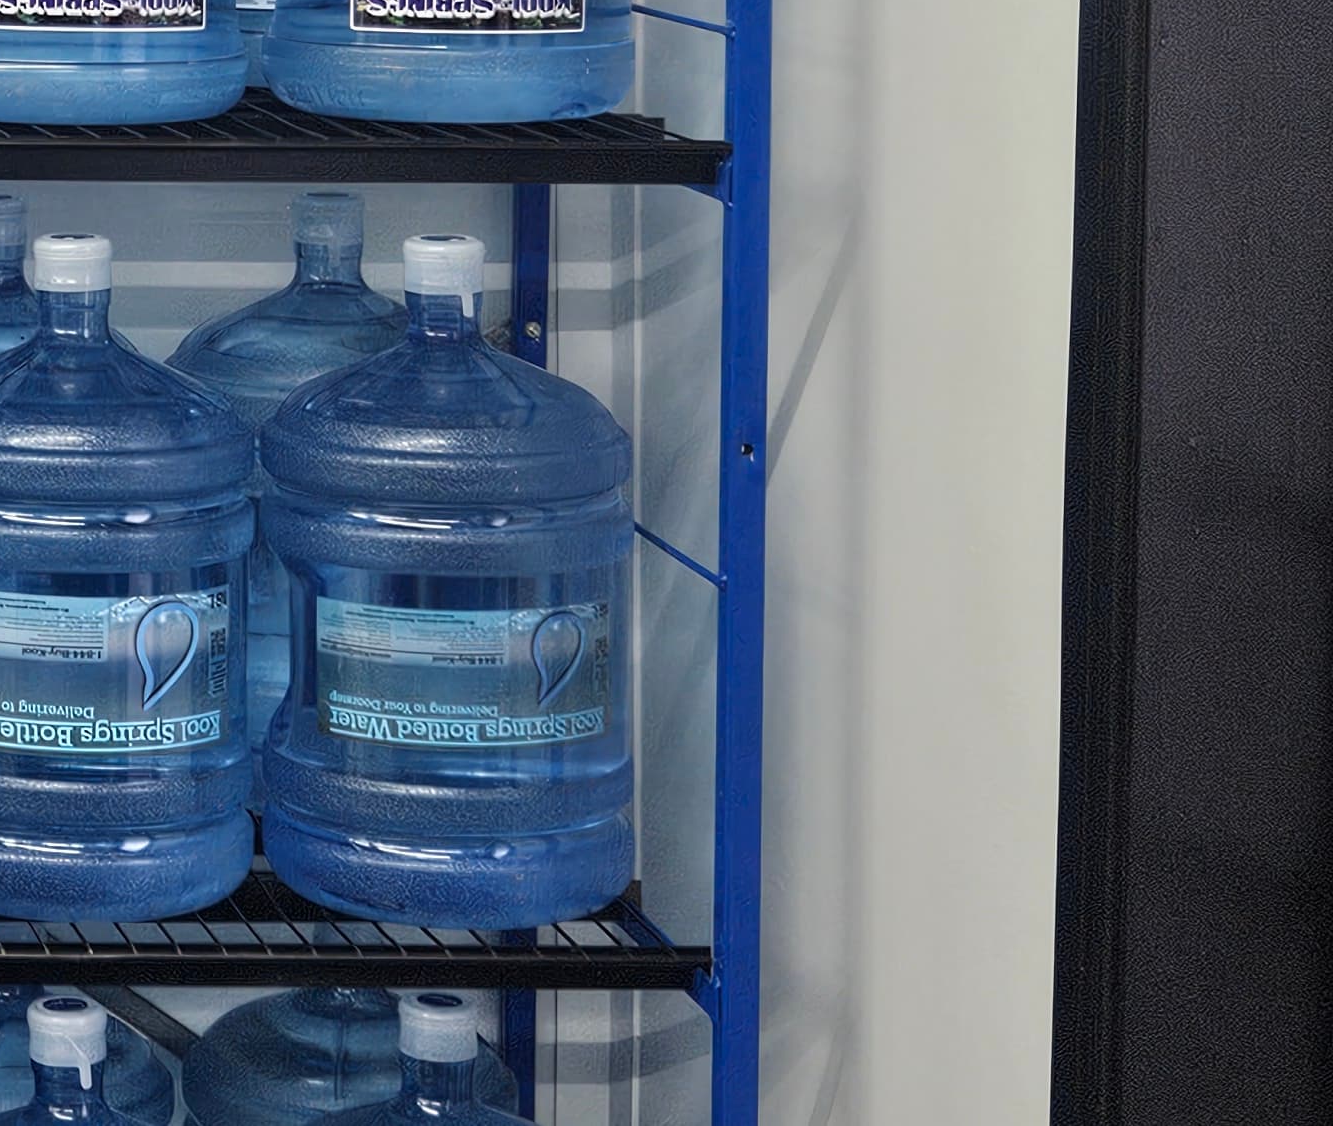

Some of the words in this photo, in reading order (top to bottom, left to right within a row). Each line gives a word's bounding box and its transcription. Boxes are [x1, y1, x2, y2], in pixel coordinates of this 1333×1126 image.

[80, 718, 175, 747] Springs
[181, 712, 222, 737] Kool
[330, 709, 392, 739] Water
[397, 718, 479, 742] Bottled
[485, 714, 567, 739] Springs
